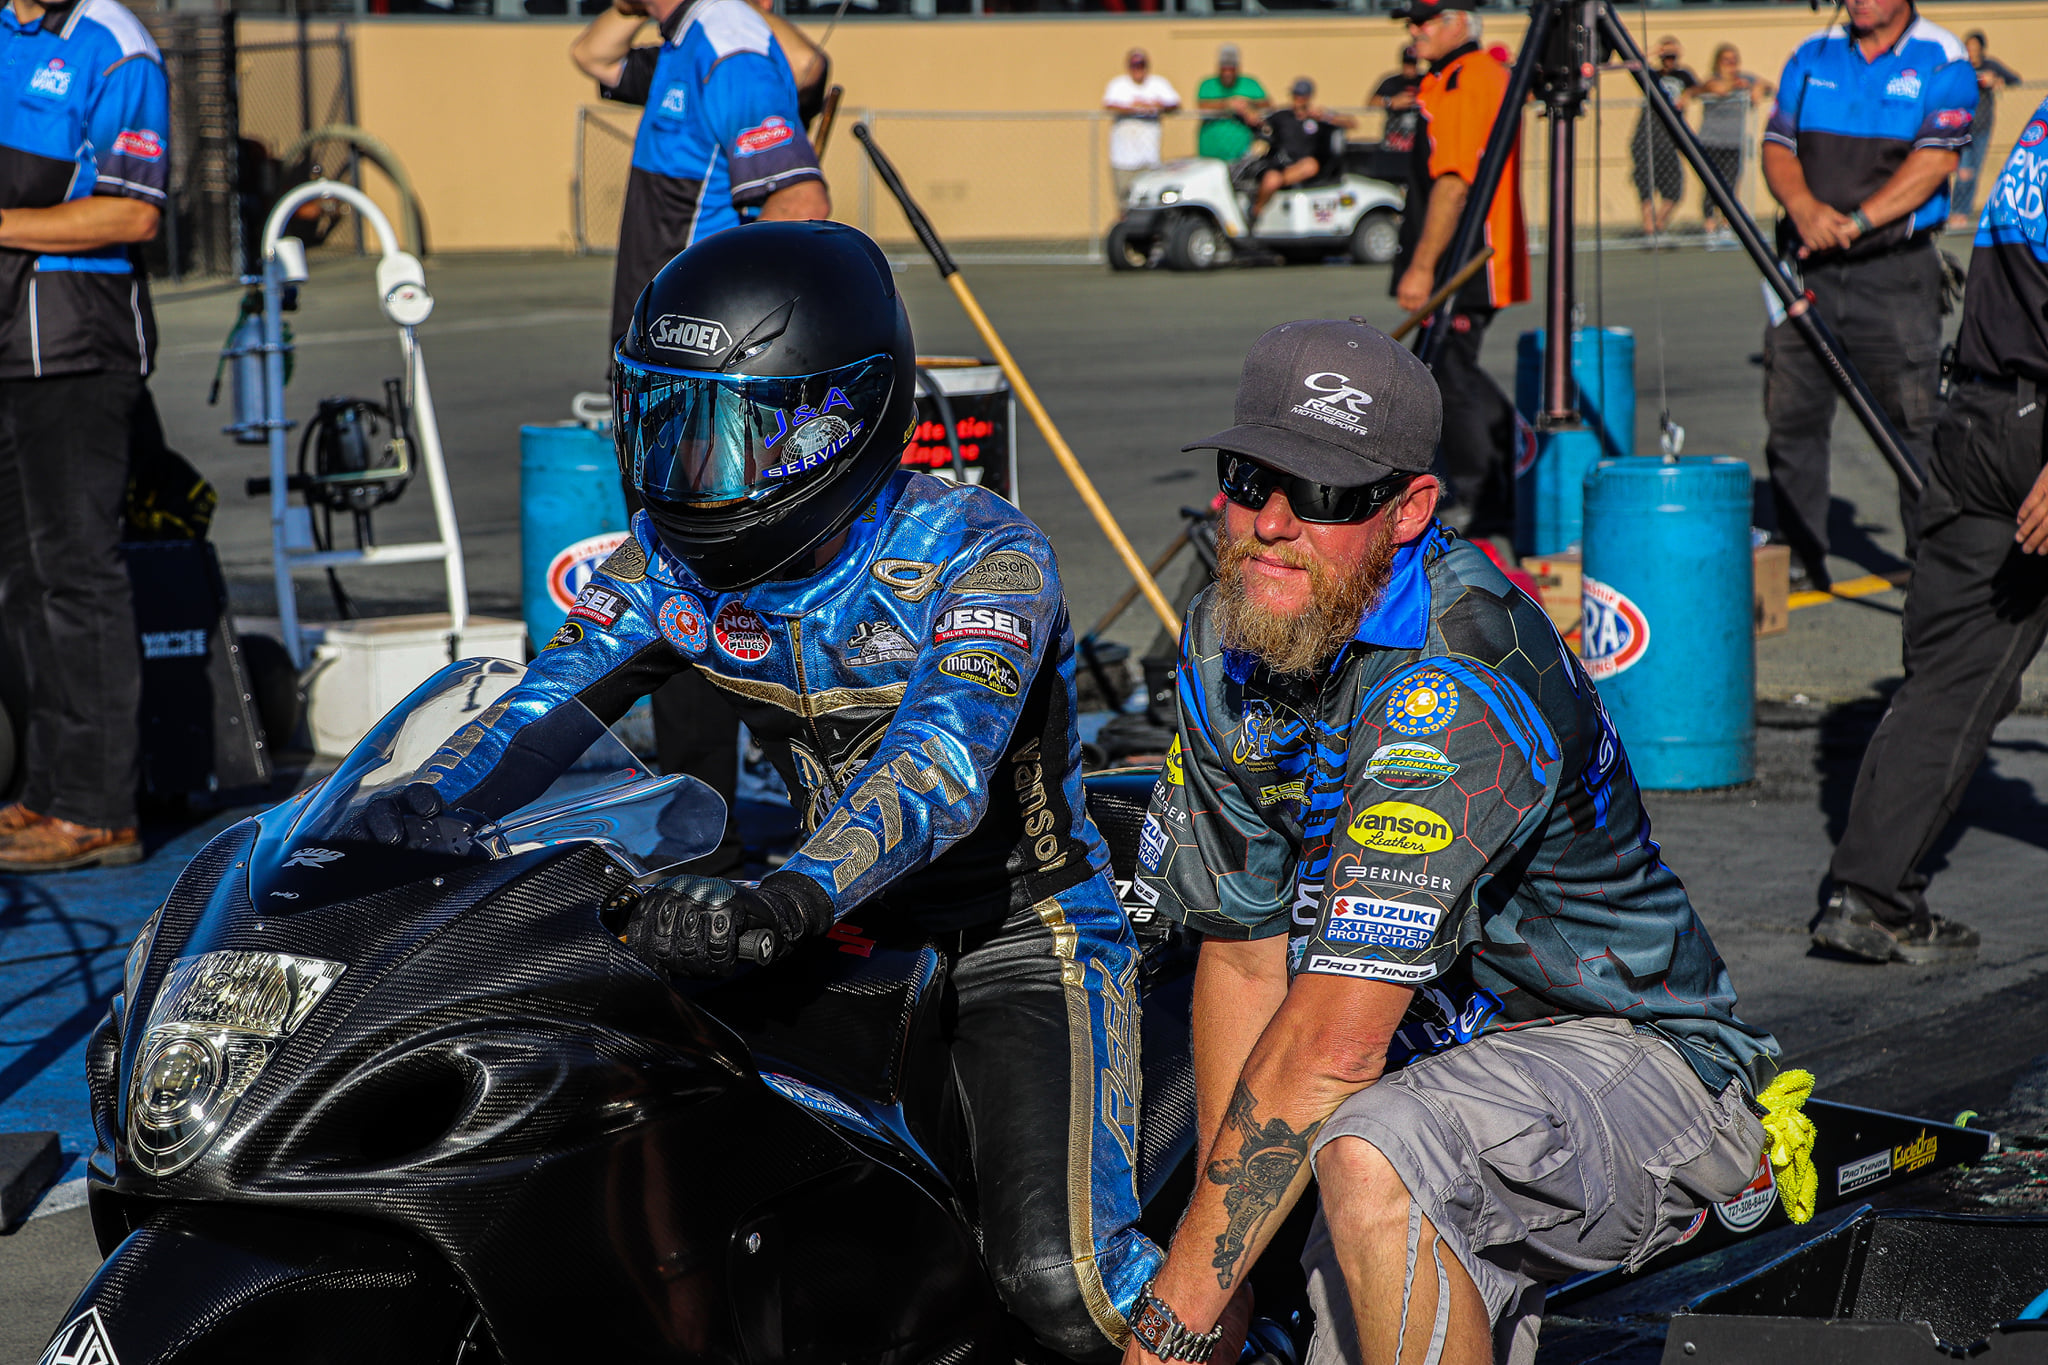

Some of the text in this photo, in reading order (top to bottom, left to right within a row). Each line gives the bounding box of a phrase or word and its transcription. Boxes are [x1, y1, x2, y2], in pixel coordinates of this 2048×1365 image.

[656, 320, 720, 351] SHOEI
[1304, 372, 1373, 415] CR
[1290, 406, 1368, 436] MOTORSPORTS
[1303, 398, 1360, 423] REED
[768, 421, 862, 477] SERVICE
[723, 616, 761, 631] NGK
[935, 610, 1027, 640] JESEL
[942, 629, 964, 639] VALVE
[965, 628, 987, 636] TRAIN
[728, 632, 763, 642] SPARK
[729, 640, 765, 651] PLUGS
[960, 671, 988, 684] copper
[1386, 671, 1447, 718] WORLDWIDE
[1389, 682, 1459, 735] BEARINGS.COM
[1369, 759, 1456, 773] PERFORMANCE
[1388, 748, 1441, 761] HIGH
[1366, 769, 1446, 781] LUBRICANTS
[799, 734, 970, 894] 574
[1354, 813, 1447, 841] vanson
[1364, 831, 1427, 853] Leathers
[1344, 865, 1452, 891] BERINGER
[1353, 902, 1436, 926] SUZUKI
[1327, 929, 1427, 949] PROTECTION
[1329, 919, 1431, 941] EXTENDED
[1906, 1153, 1936, 1173] .com
